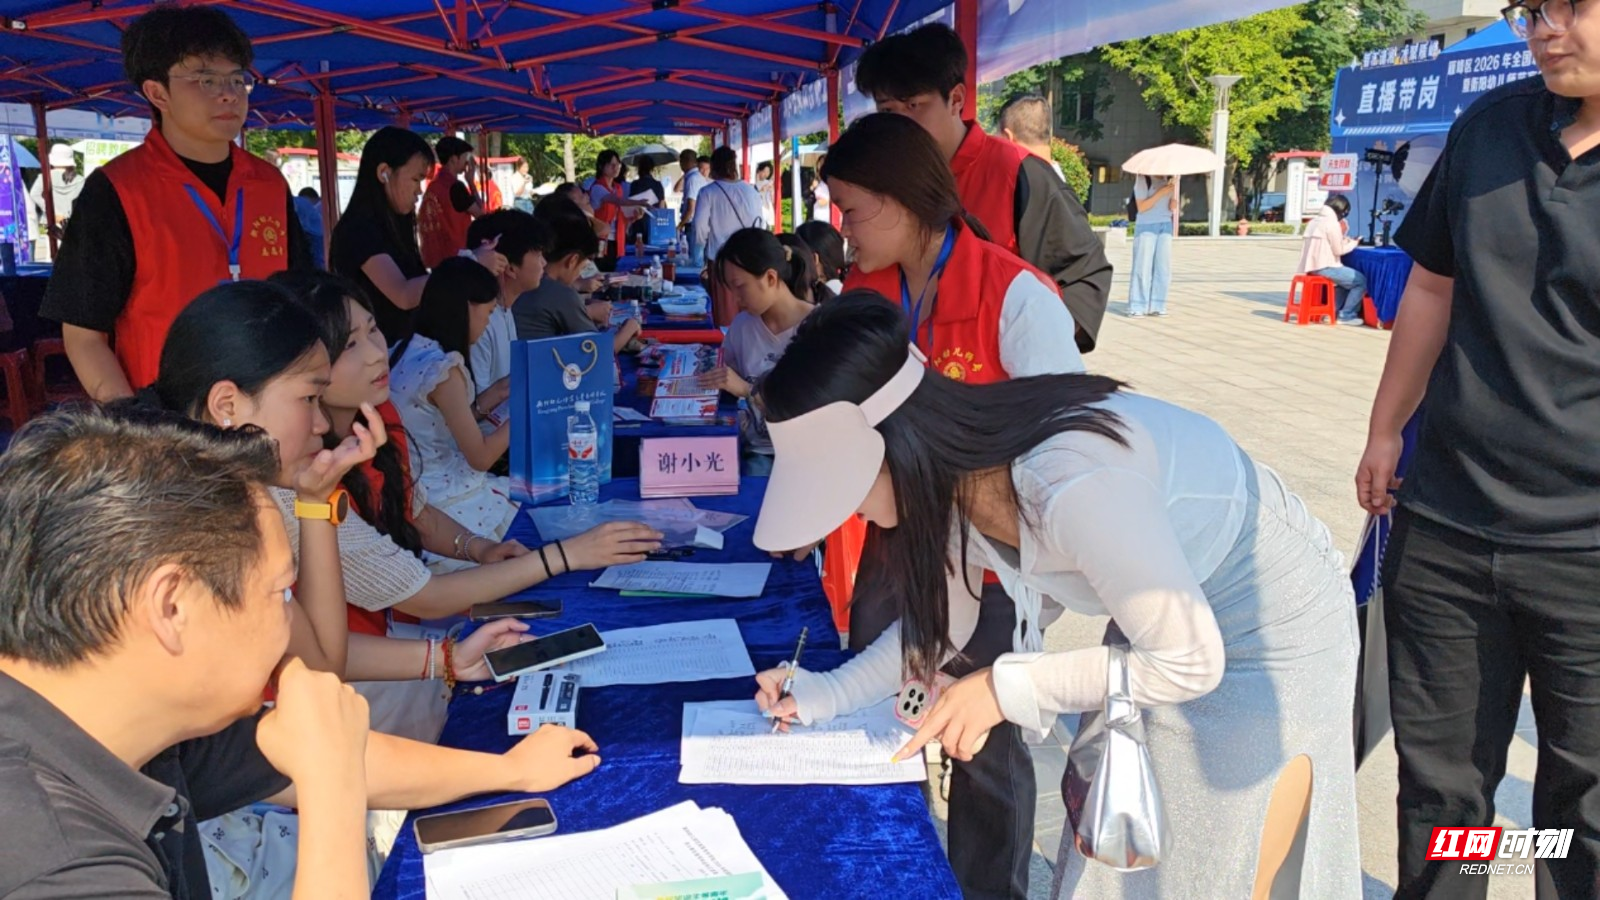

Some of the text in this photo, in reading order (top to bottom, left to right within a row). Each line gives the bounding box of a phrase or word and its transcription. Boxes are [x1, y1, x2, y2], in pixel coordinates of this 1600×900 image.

[1473, 54, 1500, 72] 2026
[1356, 74, 1441, 114] 直播带岗
[658, 451, 725, 474] 谢小光
